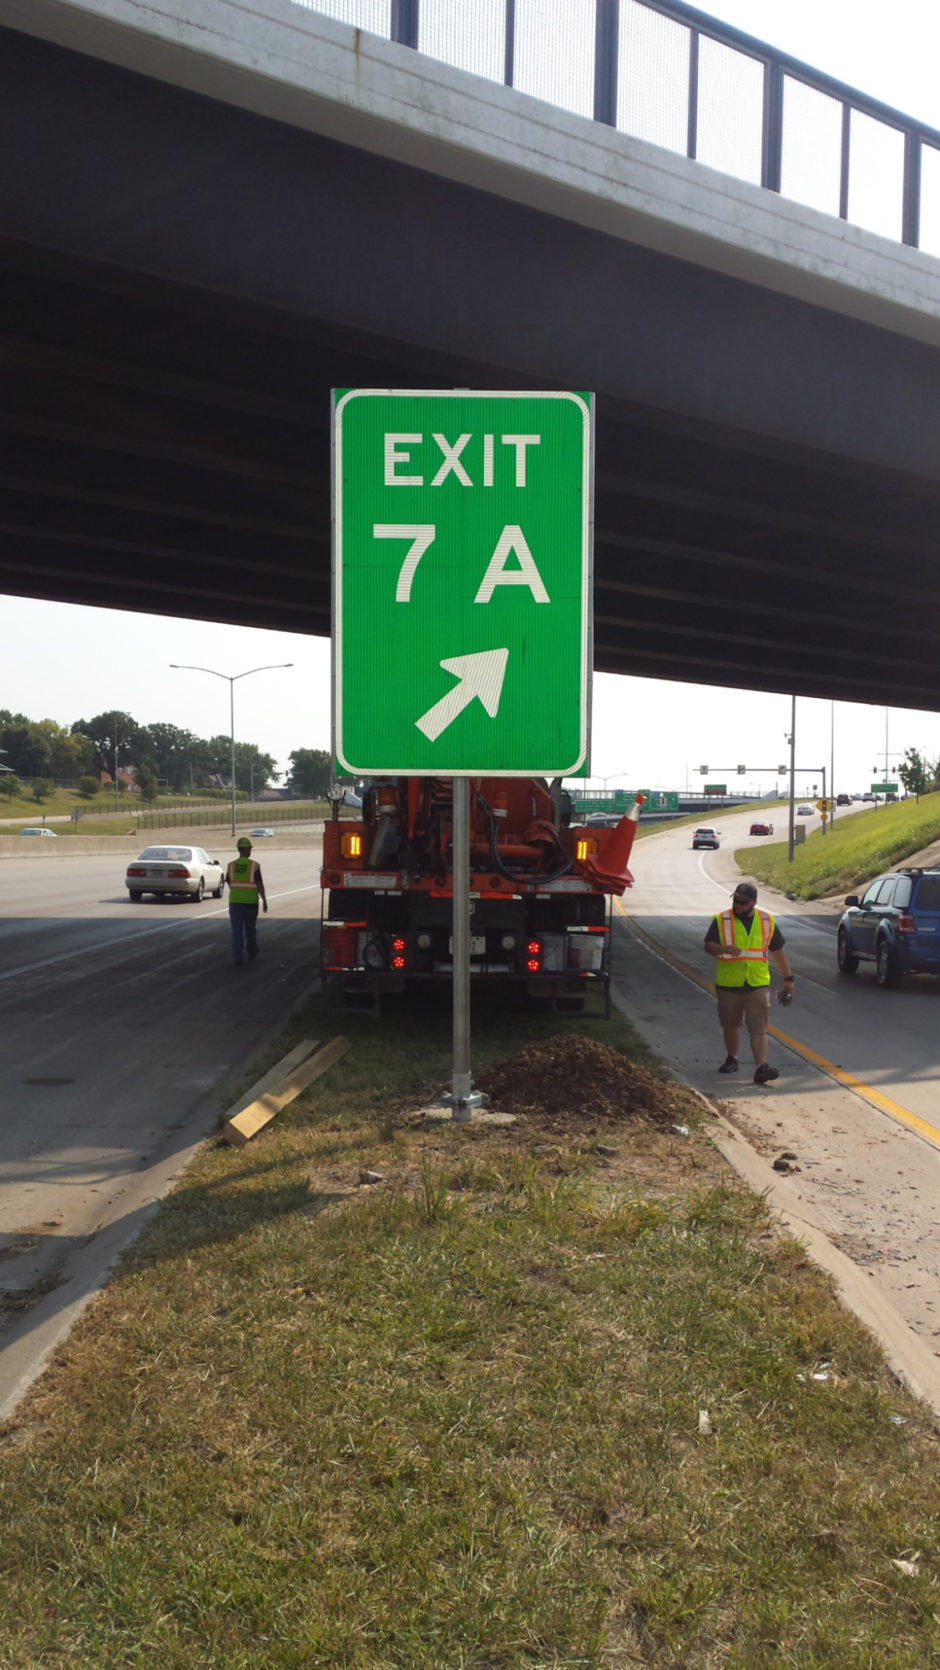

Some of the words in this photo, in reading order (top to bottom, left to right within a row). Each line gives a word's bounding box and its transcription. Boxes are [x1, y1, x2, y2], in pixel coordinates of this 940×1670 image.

[384, 432, 541, 488] EXIT
[372, 523, 436, 604] 7
[473, 524, 551, 604] A
